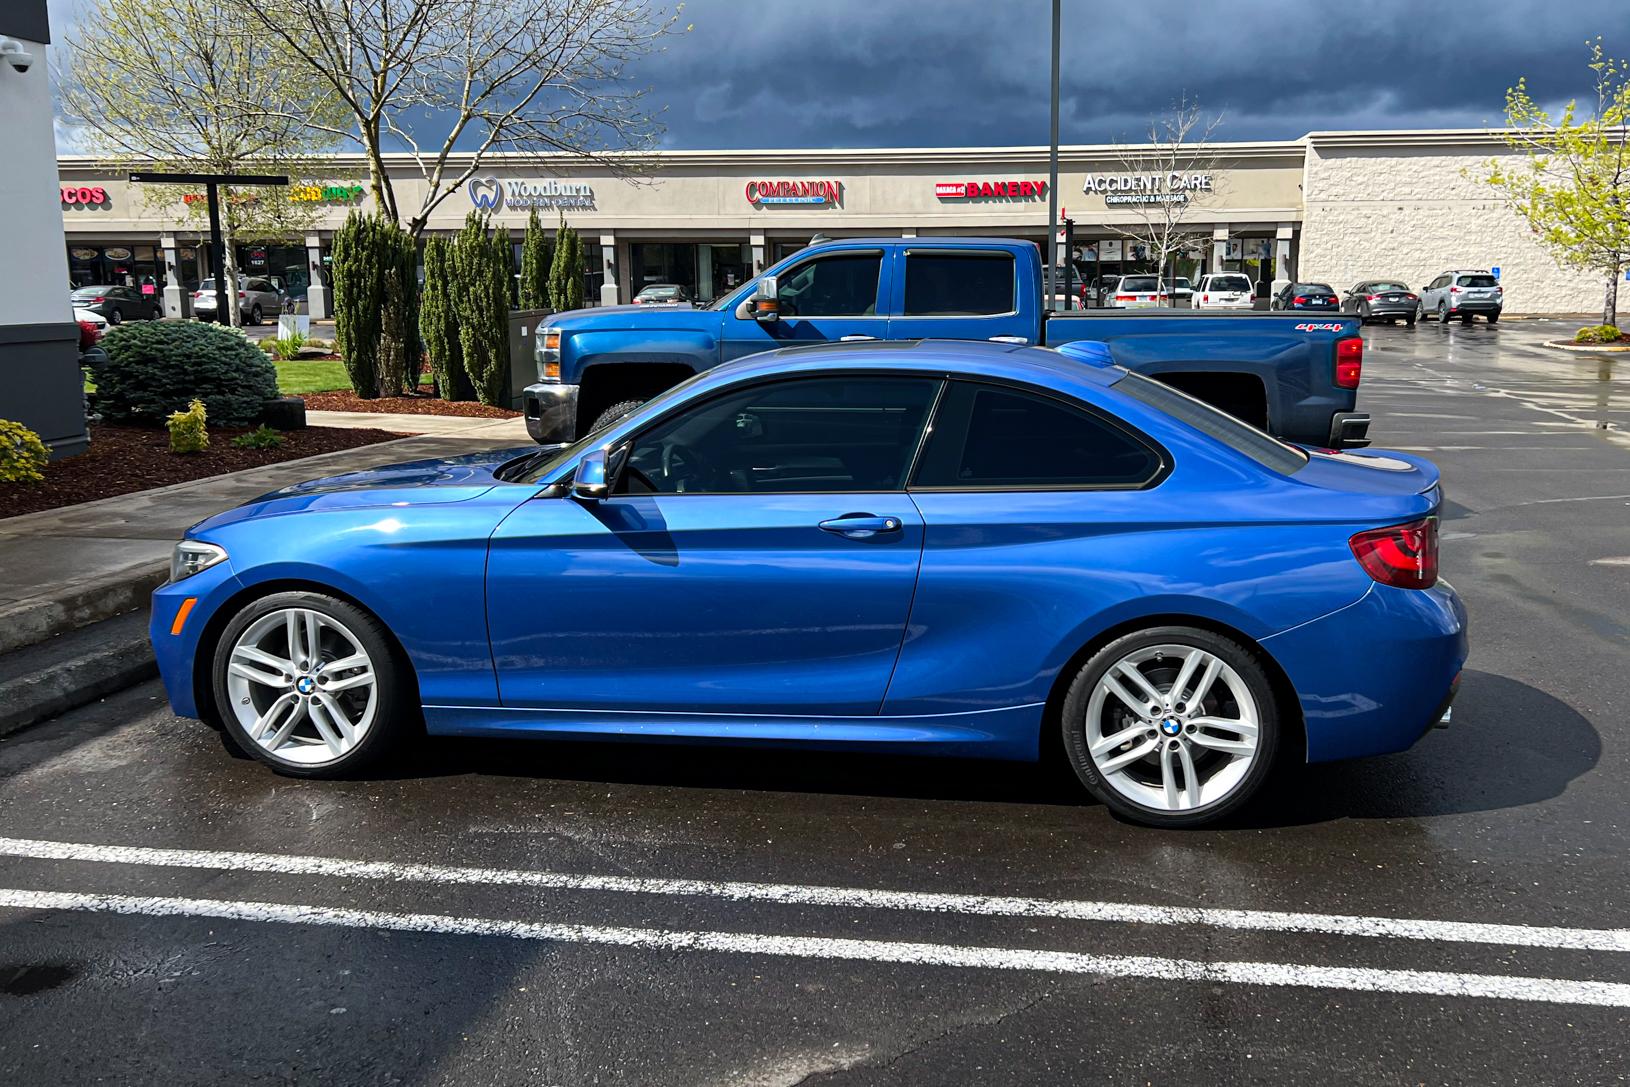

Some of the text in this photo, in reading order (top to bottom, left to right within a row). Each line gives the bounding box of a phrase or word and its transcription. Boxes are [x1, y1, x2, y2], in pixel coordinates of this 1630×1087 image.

[505, 180, 592, 196] Woodburn
[966, 181, 1046, 197] BAKERY
[1083, 171, 1212, 191] ACCIDENT CARE
[746, 181, 840, 203] COMPANION
